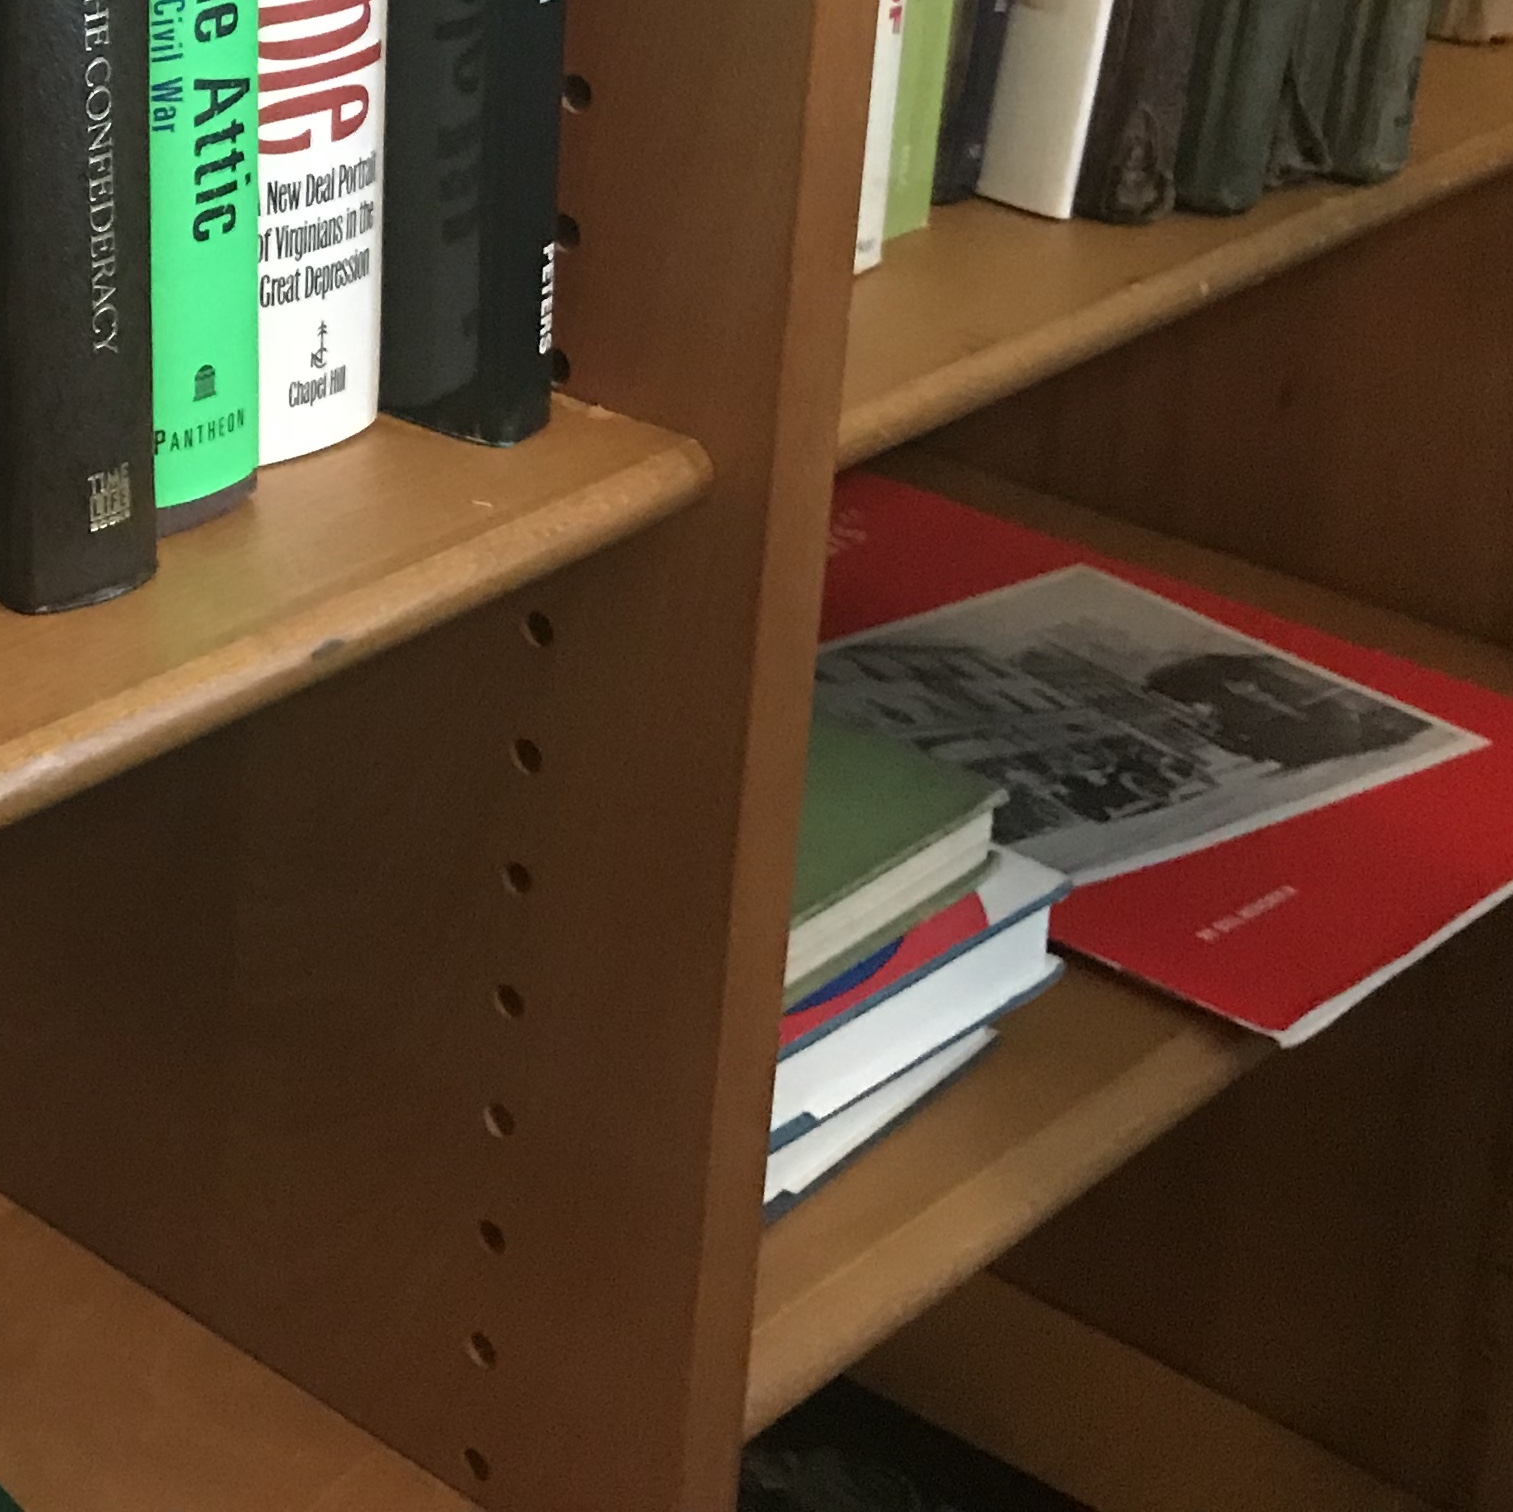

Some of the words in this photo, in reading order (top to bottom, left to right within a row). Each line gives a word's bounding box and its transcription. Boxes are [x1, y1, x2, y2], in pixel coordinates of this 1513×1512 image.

[150, 77, 186, 134] War
[192, 77, 253, 242] Attic
[85, 56, 118, 354] CONFEDERACY
[267, 180, 301, 215] New
[305, 167, 335, 207] Deal
[258, 228, 272, 263] of
[275, 215, 343, 262] Virginians
[345, 207, 357, 240] in
[359, 200, 374, 234] the
[260, 268, 301, 308] Great
[305, 248, 370, 300] Depression
[288, 372, 328, 409] Chapel
[329, 365, 347, 396] Hill
[154, 408, 244, 456] PANTHEON
